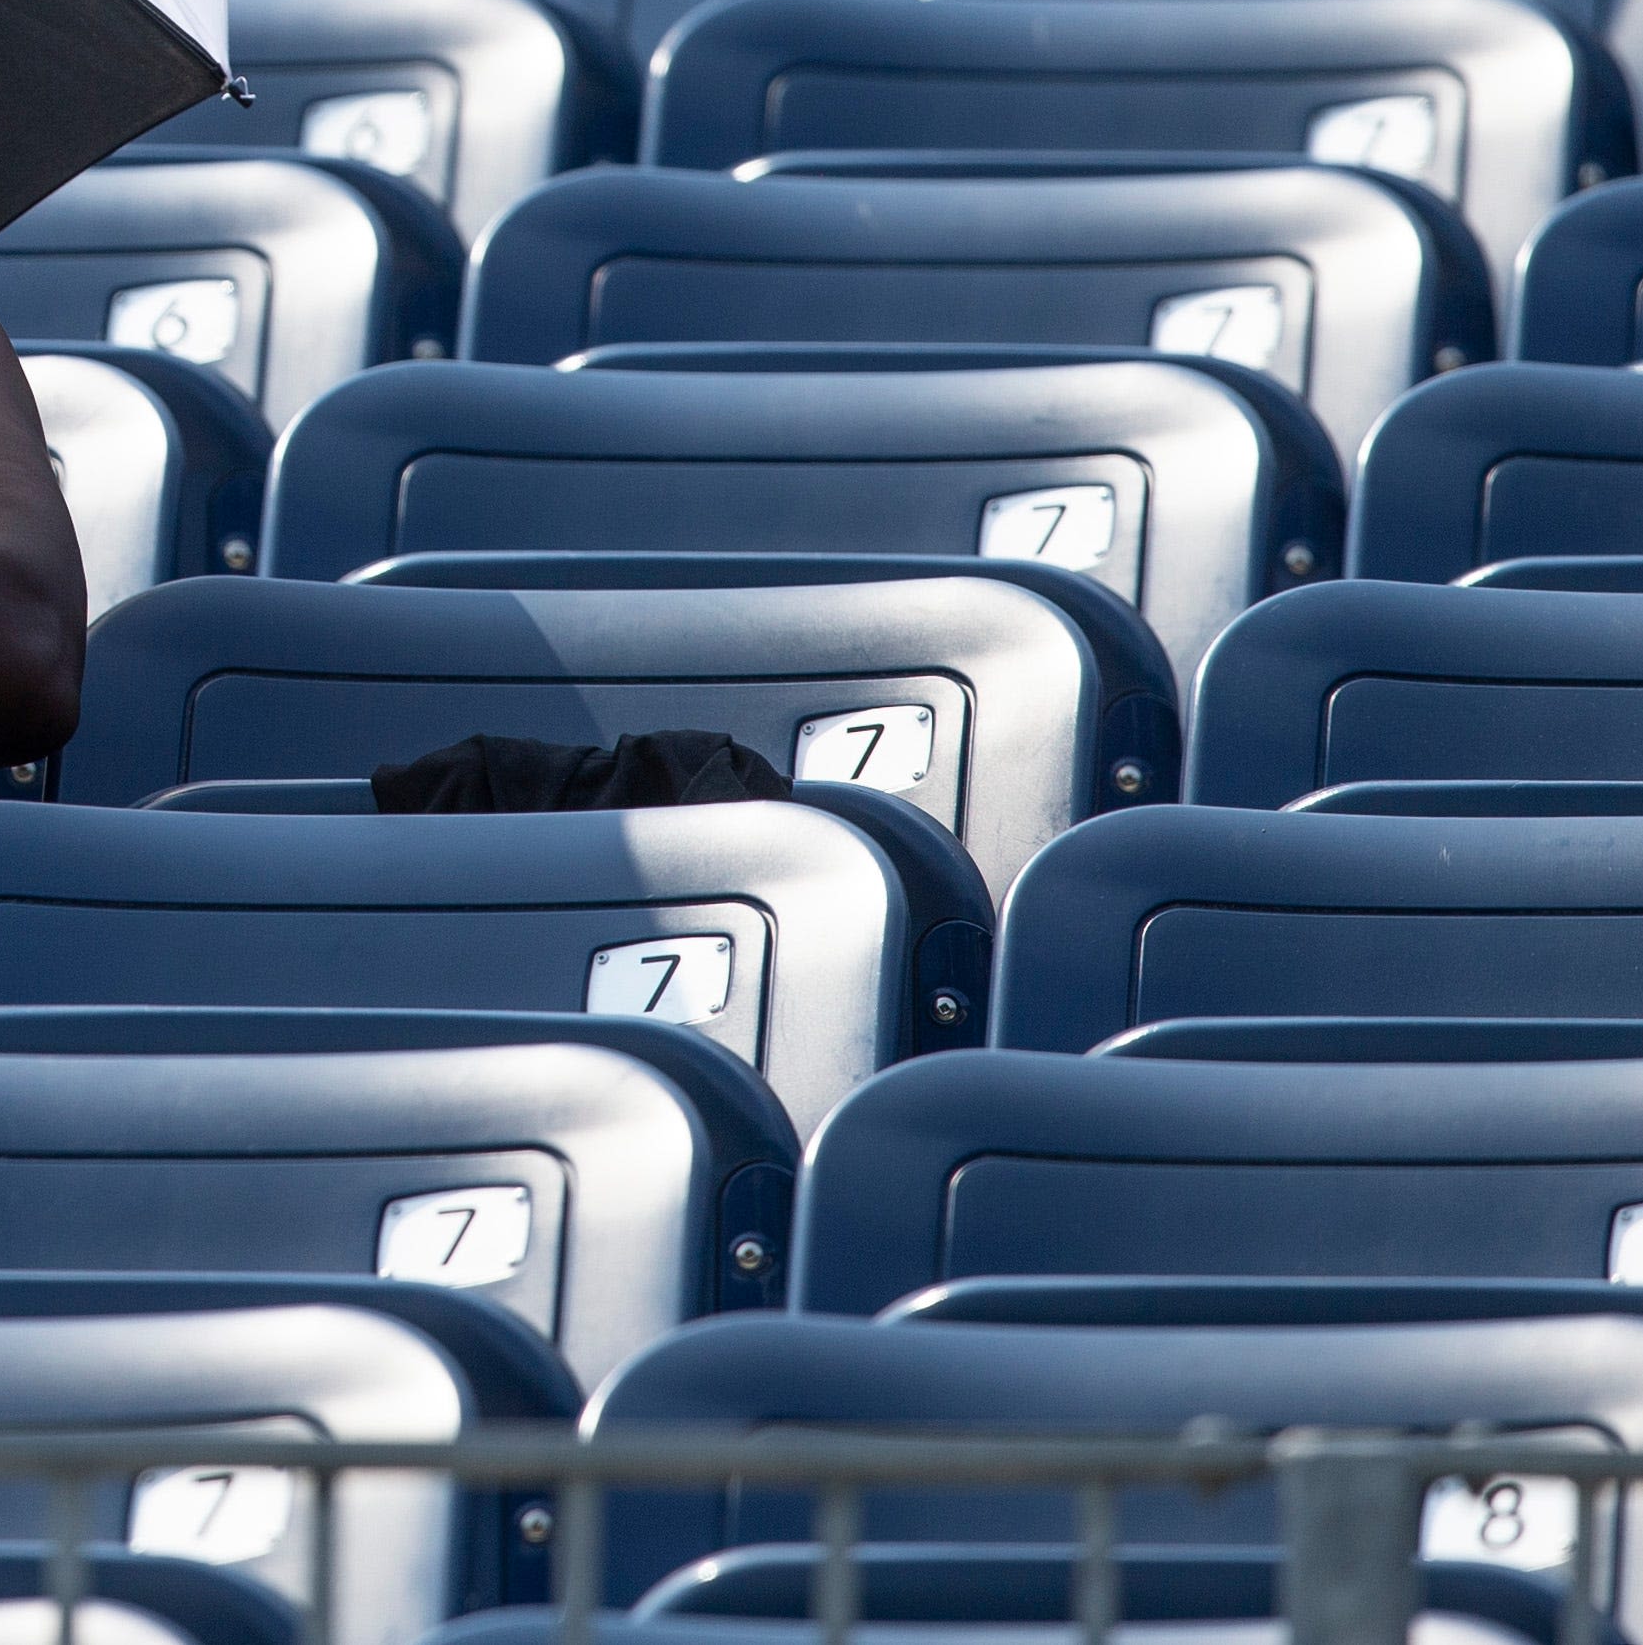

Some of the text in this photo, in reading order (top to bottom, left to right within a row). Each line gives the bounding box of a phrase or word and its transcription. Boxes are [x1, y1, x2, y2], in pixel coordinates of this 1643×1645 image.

[152, 300, 187, 350] 6
[1203, 307, 1232, 356] 7
[1032, 504, 1066, 556] 7
[846, 723, 885, 779] 7
[641, 954, 681, 1013] 7
[437, 1208, 476, 1265] 7
[195, 1475, 232, 1537] 7
[1481, 1483, 1524, 1549] 8
